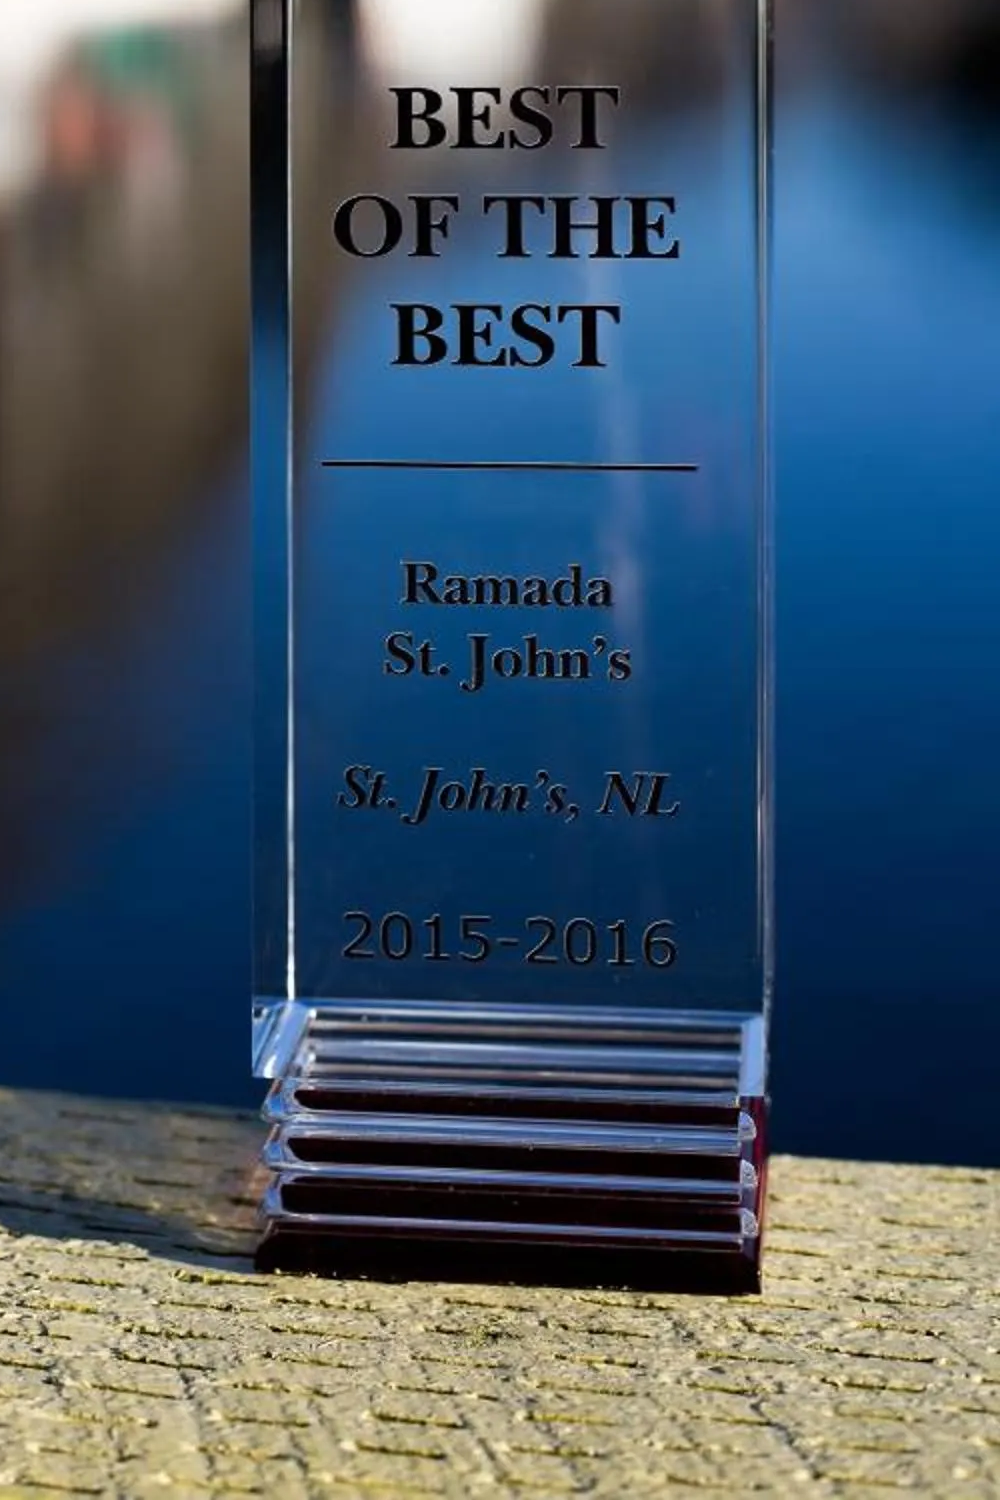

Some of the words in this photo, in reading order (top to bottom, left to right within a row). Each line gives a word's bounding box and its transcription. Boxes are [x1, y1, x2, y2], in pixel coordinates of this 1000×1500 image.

[388, 86, 619, 150] BEST
[333, 194, 459, 258] OF
[483, 196, 680, 260] THE
[390, 303, 620, 368] BEST
[400, 560, 615, 608] Ramada
[383, 631, 450, 677] St.
[460, 633, 632, 693] John's
[337, 764, 396, 810] St.
[401, 767, 580, 826] John's,
[597, 771, 682, 817] NL
[341, 911, 678, 969] 2015-2016
